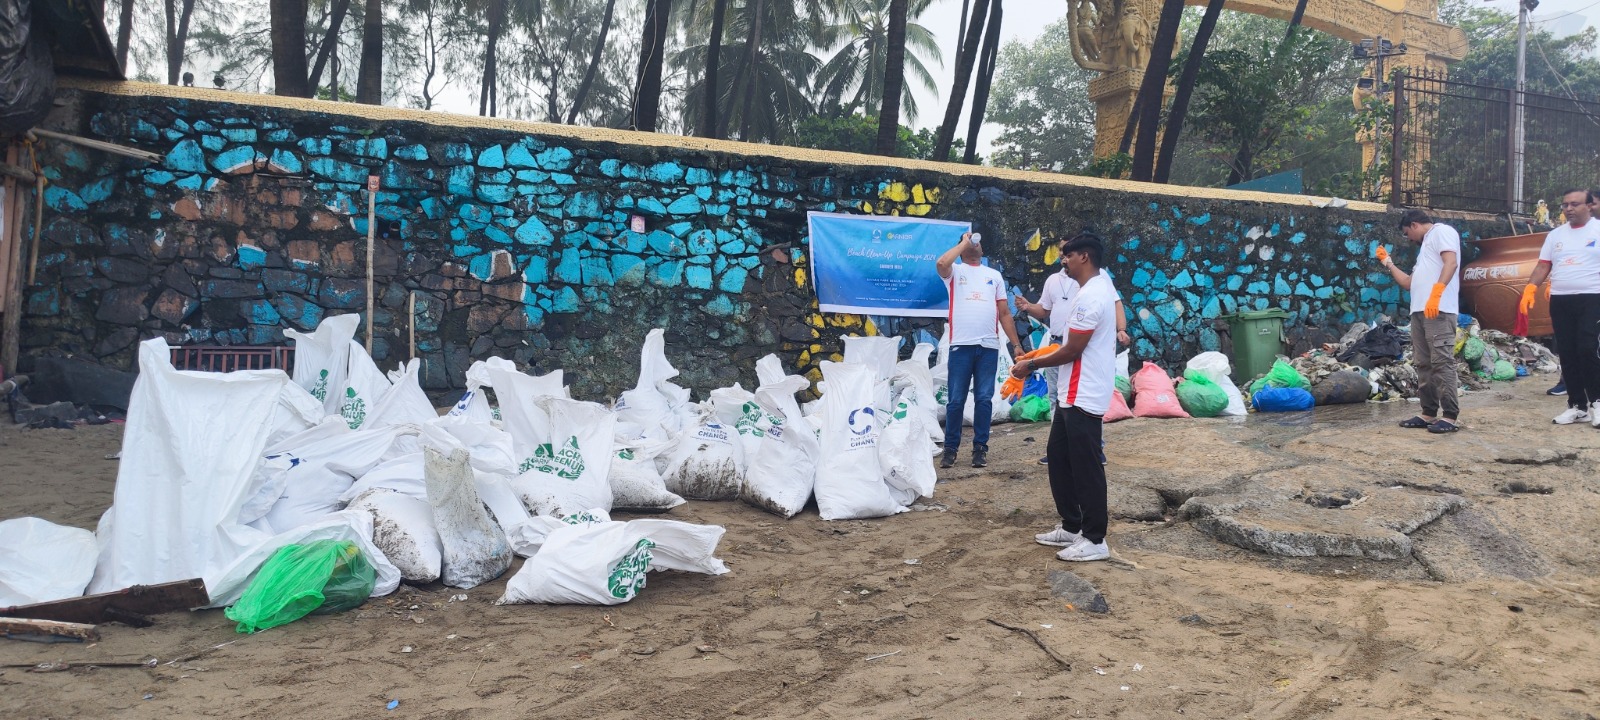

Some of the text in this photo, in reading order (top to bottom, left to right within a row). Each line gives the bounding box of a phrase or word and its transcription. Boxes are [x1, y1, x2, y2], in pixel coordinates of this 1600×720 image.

[887, 232, 913, 240] GARNIER
[847, 247, 865, 257] Beach
[866, 249, 893, 260] Clean-Up
[896, 251, 922, 262] Campaign
[698, 430, 728, 441] CHANGE
